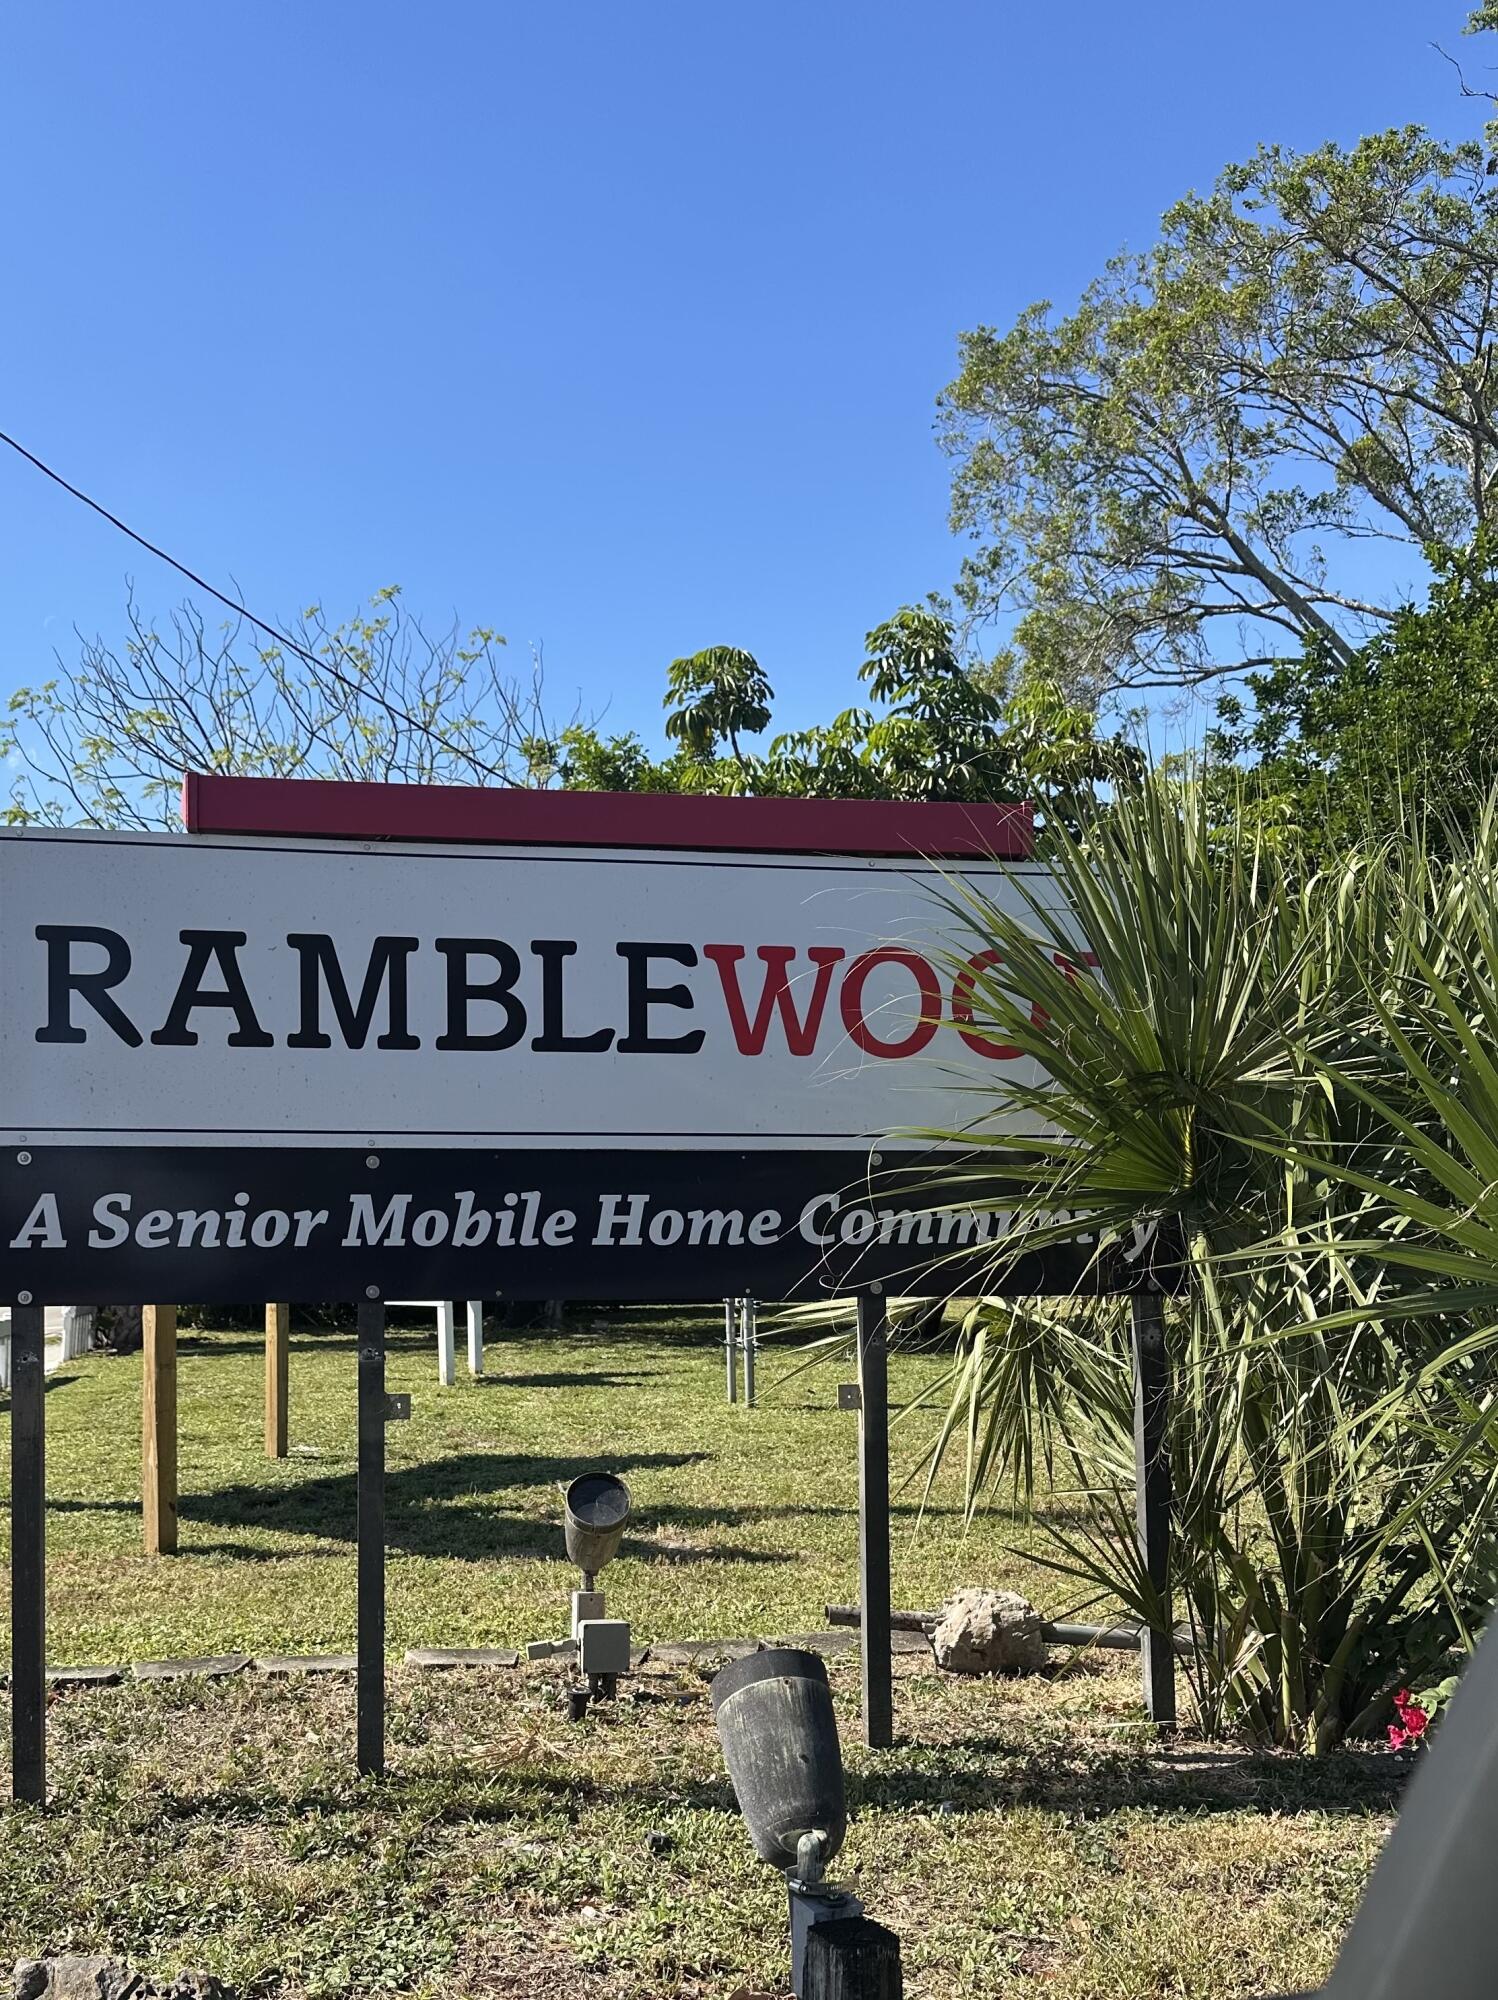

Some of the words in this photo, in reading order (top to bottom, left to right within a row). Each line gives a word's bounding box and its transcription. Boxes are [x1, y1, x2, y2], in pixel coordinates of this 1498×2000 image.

[35, 924, 1104, 1060] RAMBLEWOO
[9, 1193, 67, 1249] A
[88, 1192, 329, 1249] Senior
[341, 1190, 577, 1248] Mobile
[592, 1194, 782, 1246] Home
